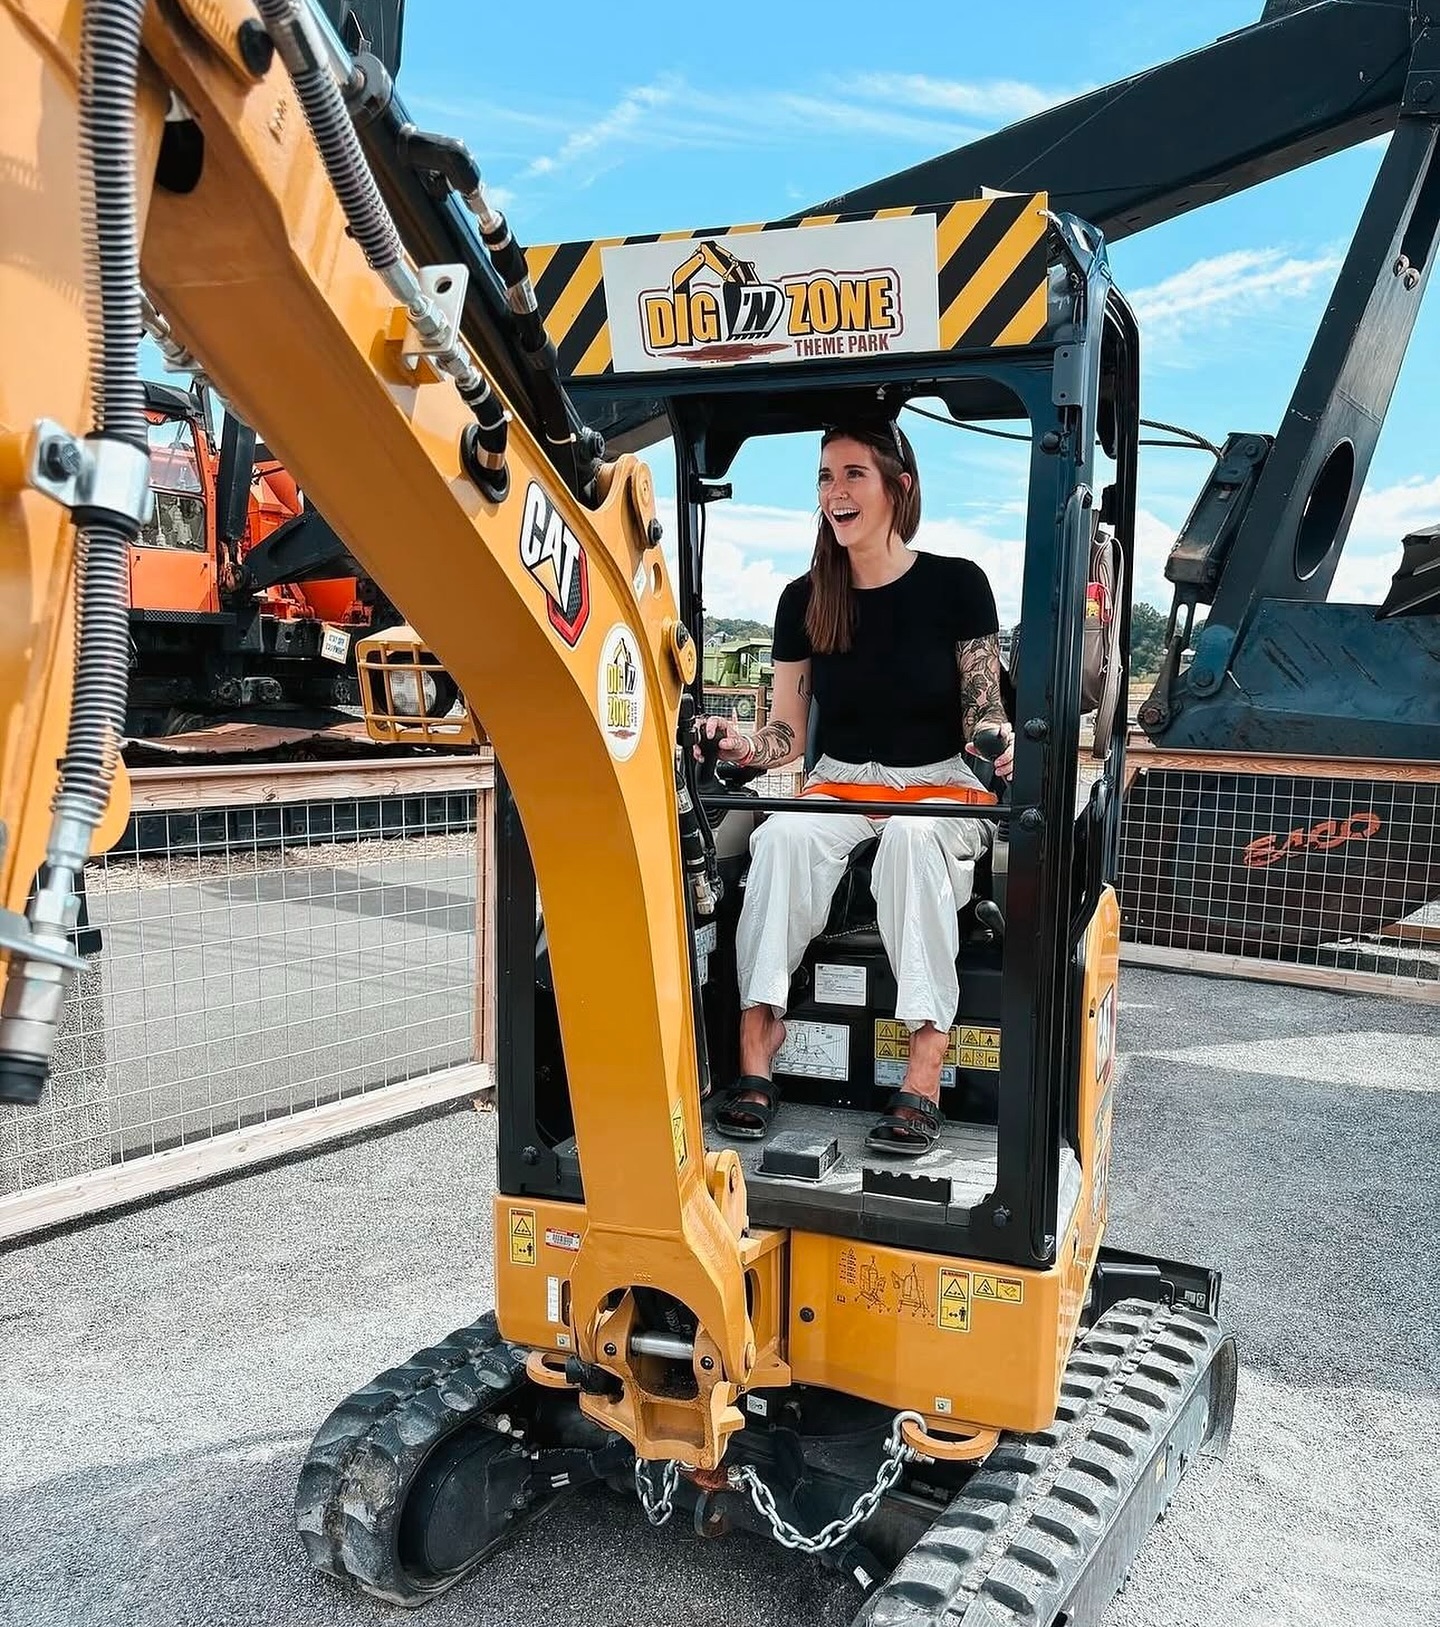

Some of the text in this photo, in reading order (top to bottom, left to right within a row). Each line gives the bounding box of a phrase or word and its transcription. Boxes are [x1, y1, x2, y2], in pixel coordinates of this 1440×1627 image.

[645, 292, 721, 348] DIG
[785, 278, 895, 338] ZONE
[794, 333, 891, 357] THEME PARK
[521, 481, 581, 613] CAT
[607, 664, 624, 694] DIG
[607, 696, 631, 728] ZONE
